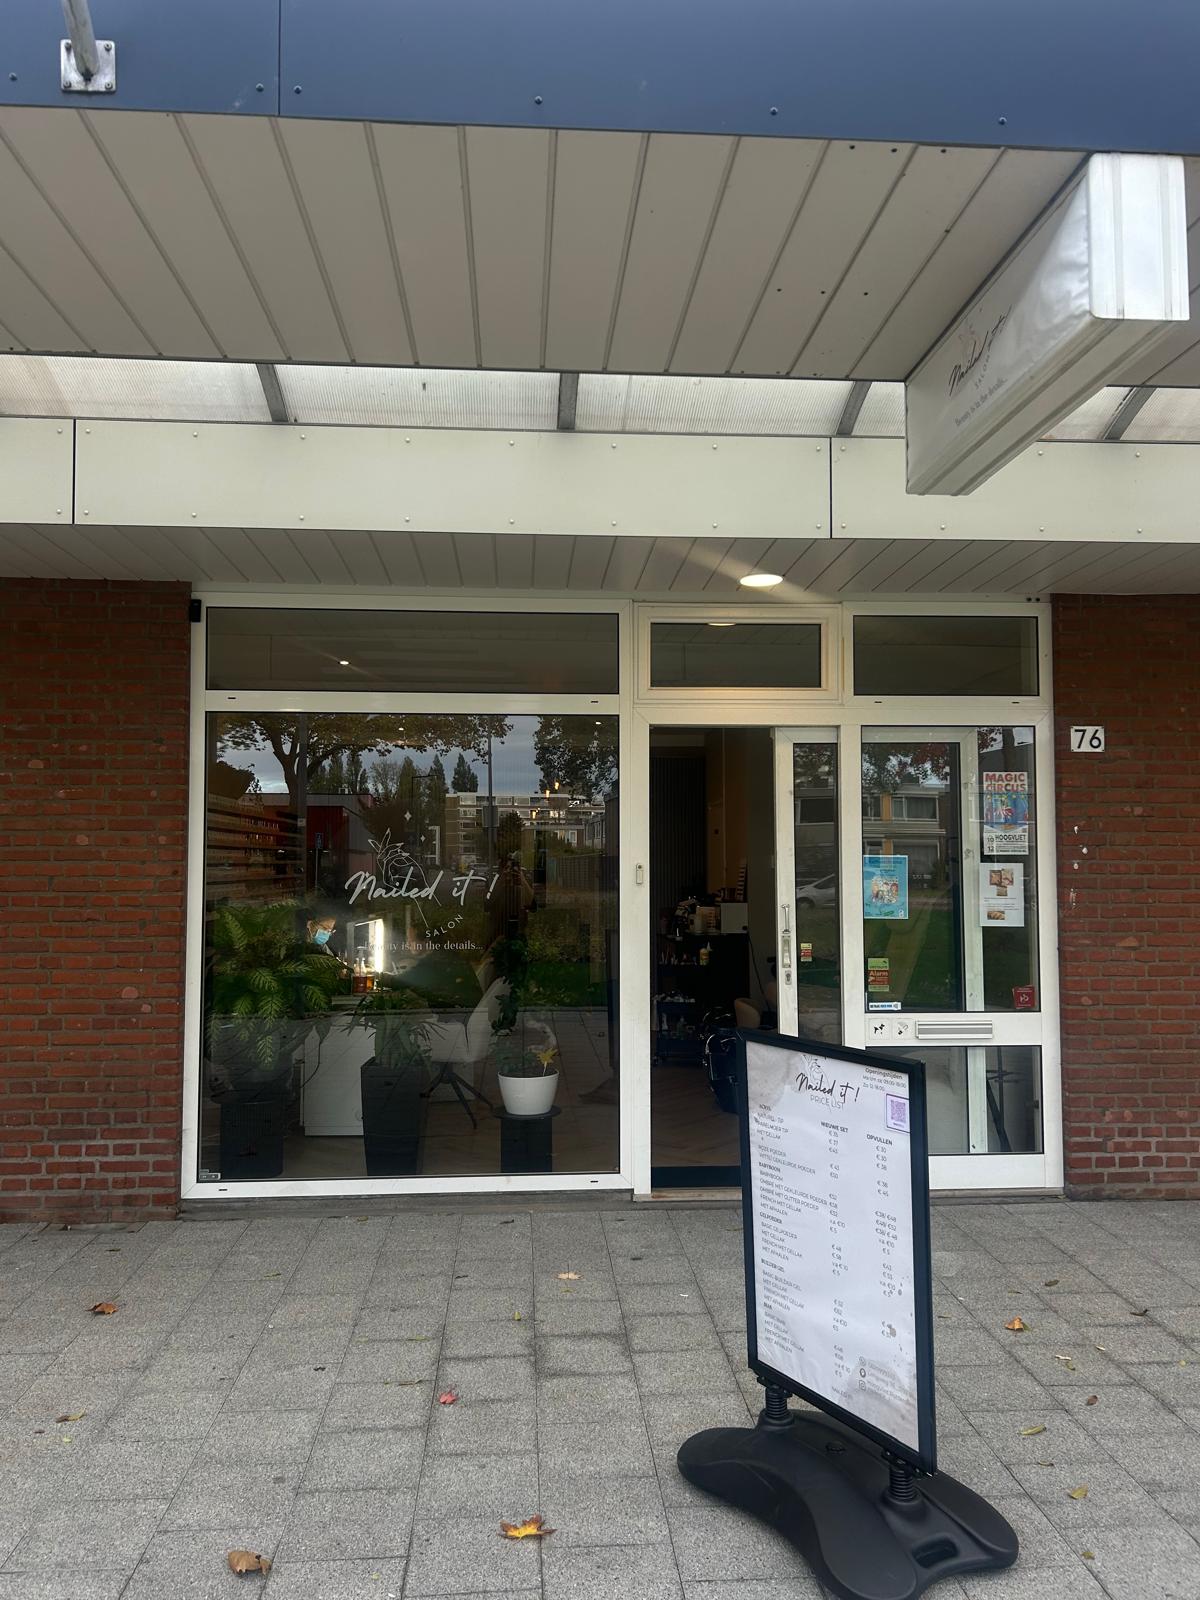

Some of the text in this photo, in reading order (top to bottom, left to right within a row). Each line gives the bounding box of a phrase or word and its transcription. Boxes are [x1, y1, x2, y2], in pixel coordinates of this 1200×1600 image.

[1074, 729, 1101, 749] 76
[985, 773, 1025, 782] MAGIC
[985, 783, 1026, 792] CIRCUS
[345, 866, 444, 905] Nailed
[452, 870, 487, 906] it
[425, 914, 464, 938] SALON
[425, 941, 441, 950] the
[444, 940, 483, 950] details...
[864, 1067, 902, 1081] Openingstijden
[796, 1072, 836, 1097] Nailed
[839, 1083, 854, 1104] it
[810, 1097, 845, 1111] PRICE LIST
[820, 1120, 848, 1133] NIEUWE SET
[866, 1133, 892, 1145] OPVULLEN
[758, 1161, 780, 1173] BABYBOOM
